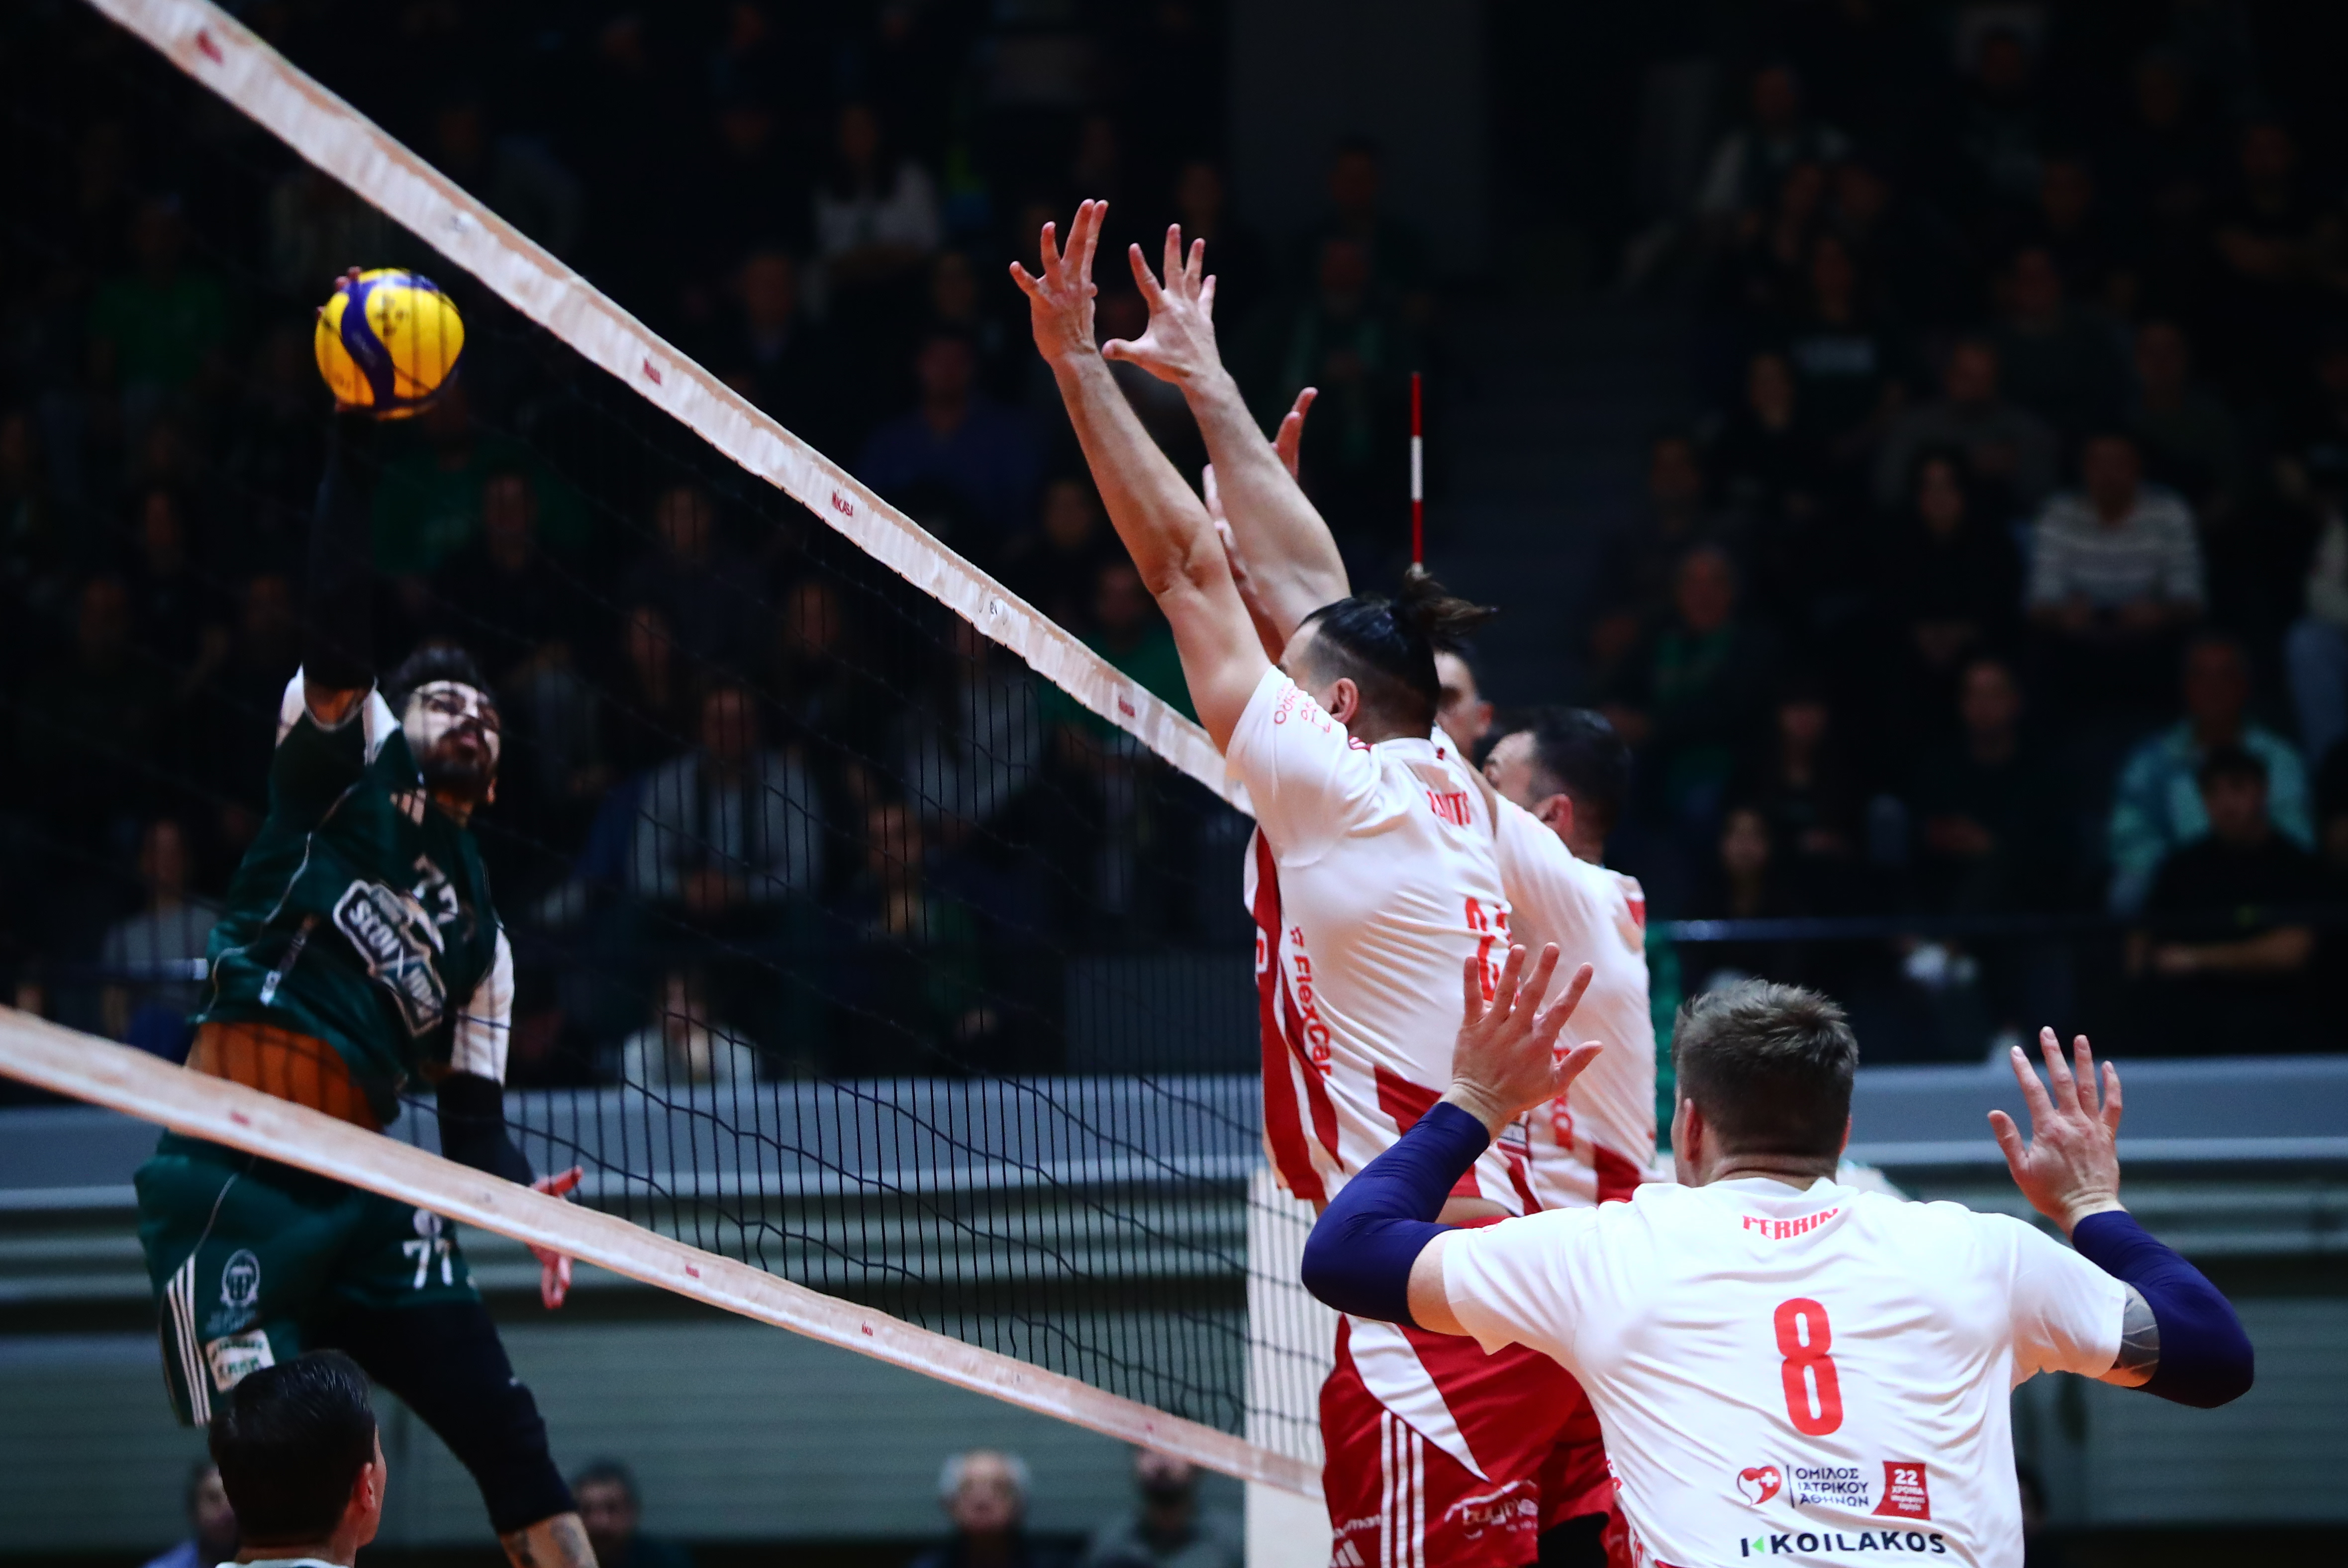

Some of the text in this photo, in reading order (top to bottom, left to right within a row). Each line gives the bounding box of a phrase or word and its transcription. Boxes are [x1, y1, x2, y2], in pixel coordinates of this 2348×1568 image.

[1742, 1207, 1839, 1240] PERRIN
[1773, 1297, 1844, 1436] 8
[1795, 1468, 1859, 1480] ΟΜΙΛΟΣ
[1893, 1468, 1919, 1486] 22
[1798, 1481, 1869, 1494] ΙΑΤΡΙΚΟΥ
[1799, 1493, 1869, 1507] ΑΘΗΝΩΝ
[1770, 1531, 1946, 1555] KOILAKOS
